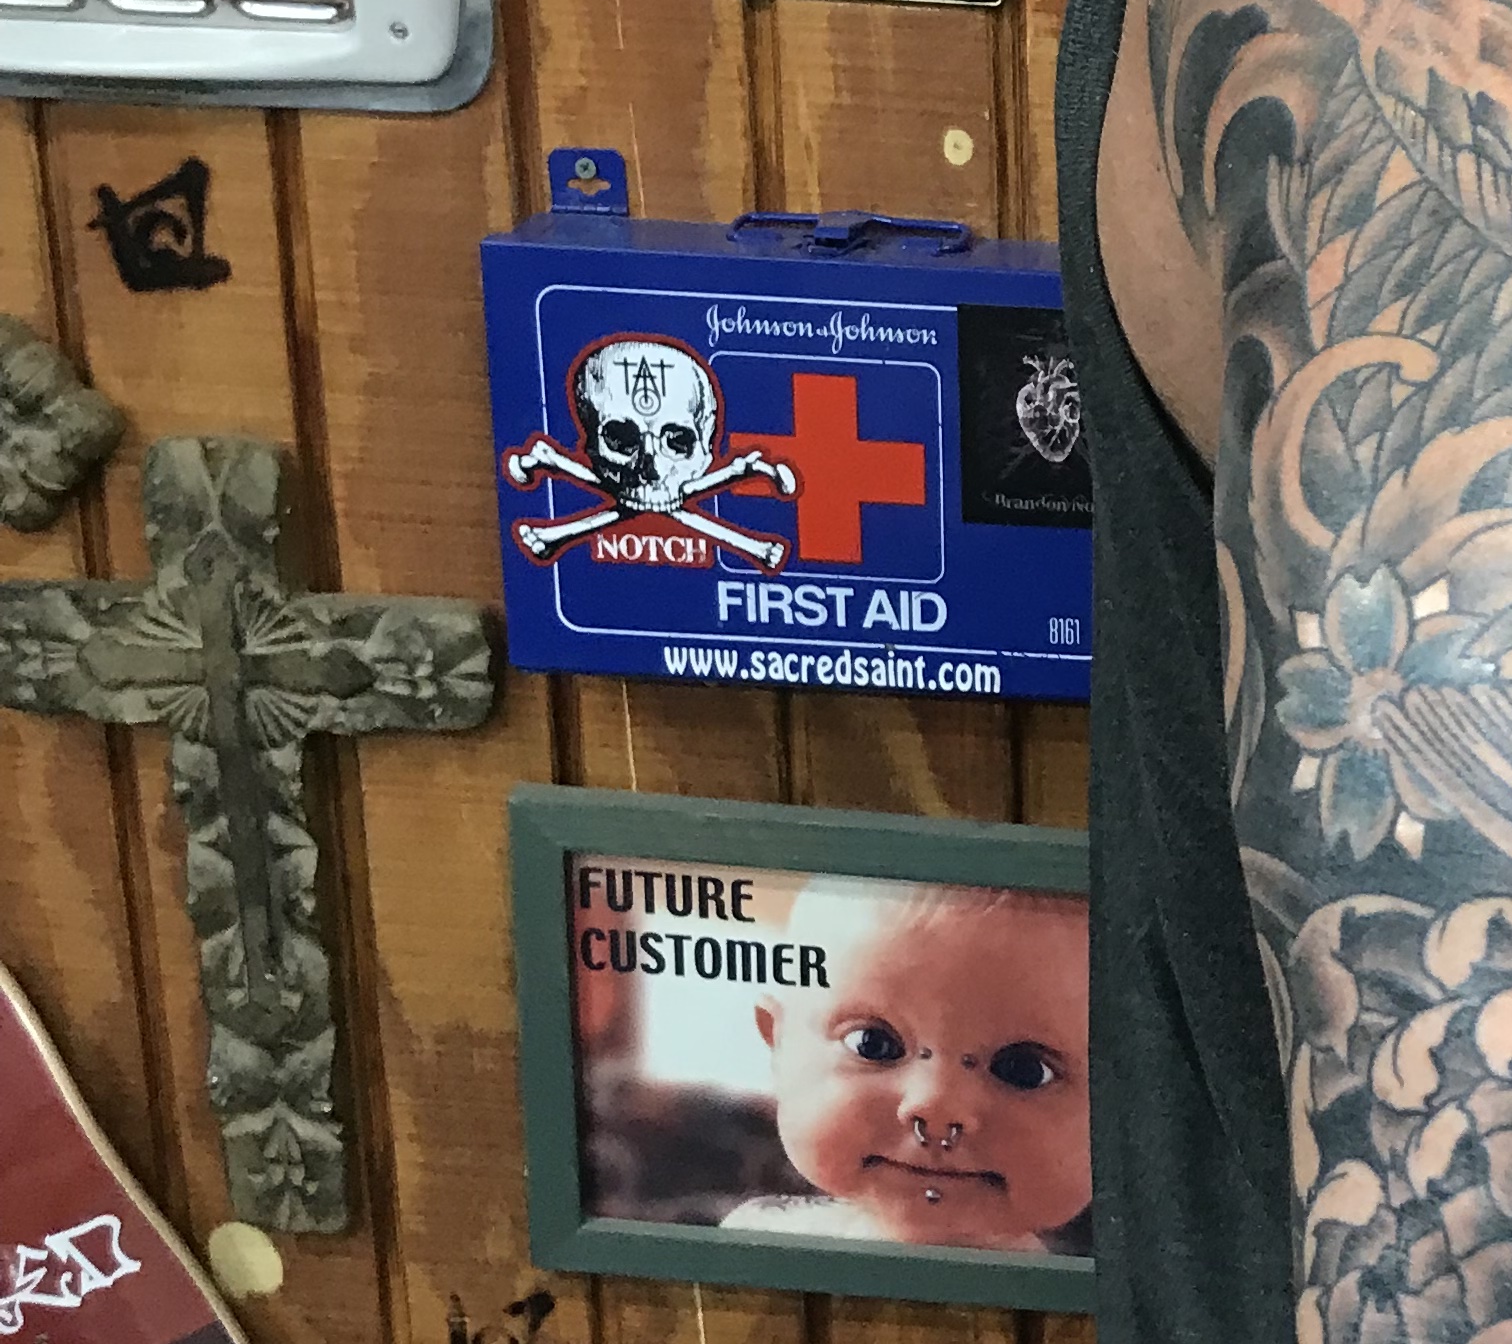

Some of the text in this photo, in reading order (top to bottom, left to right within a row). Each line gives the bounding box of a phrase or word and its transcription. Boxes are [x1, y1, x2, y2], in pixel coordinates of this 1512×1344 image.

[706, 304, 813, 348] Johnson
[827, 310, 938, 354] Johnson
[596, 533, 708, 564] NOTCH
[716, 580, 948, 632] FIRST AID
[1049, 616, 1081, 646] 8161
[662, 646, 1002, 694] www.sacredsaint.com
[578, 865, 756, 923] FUTURE
[580, 927, 831, 989] CUSTOMER
